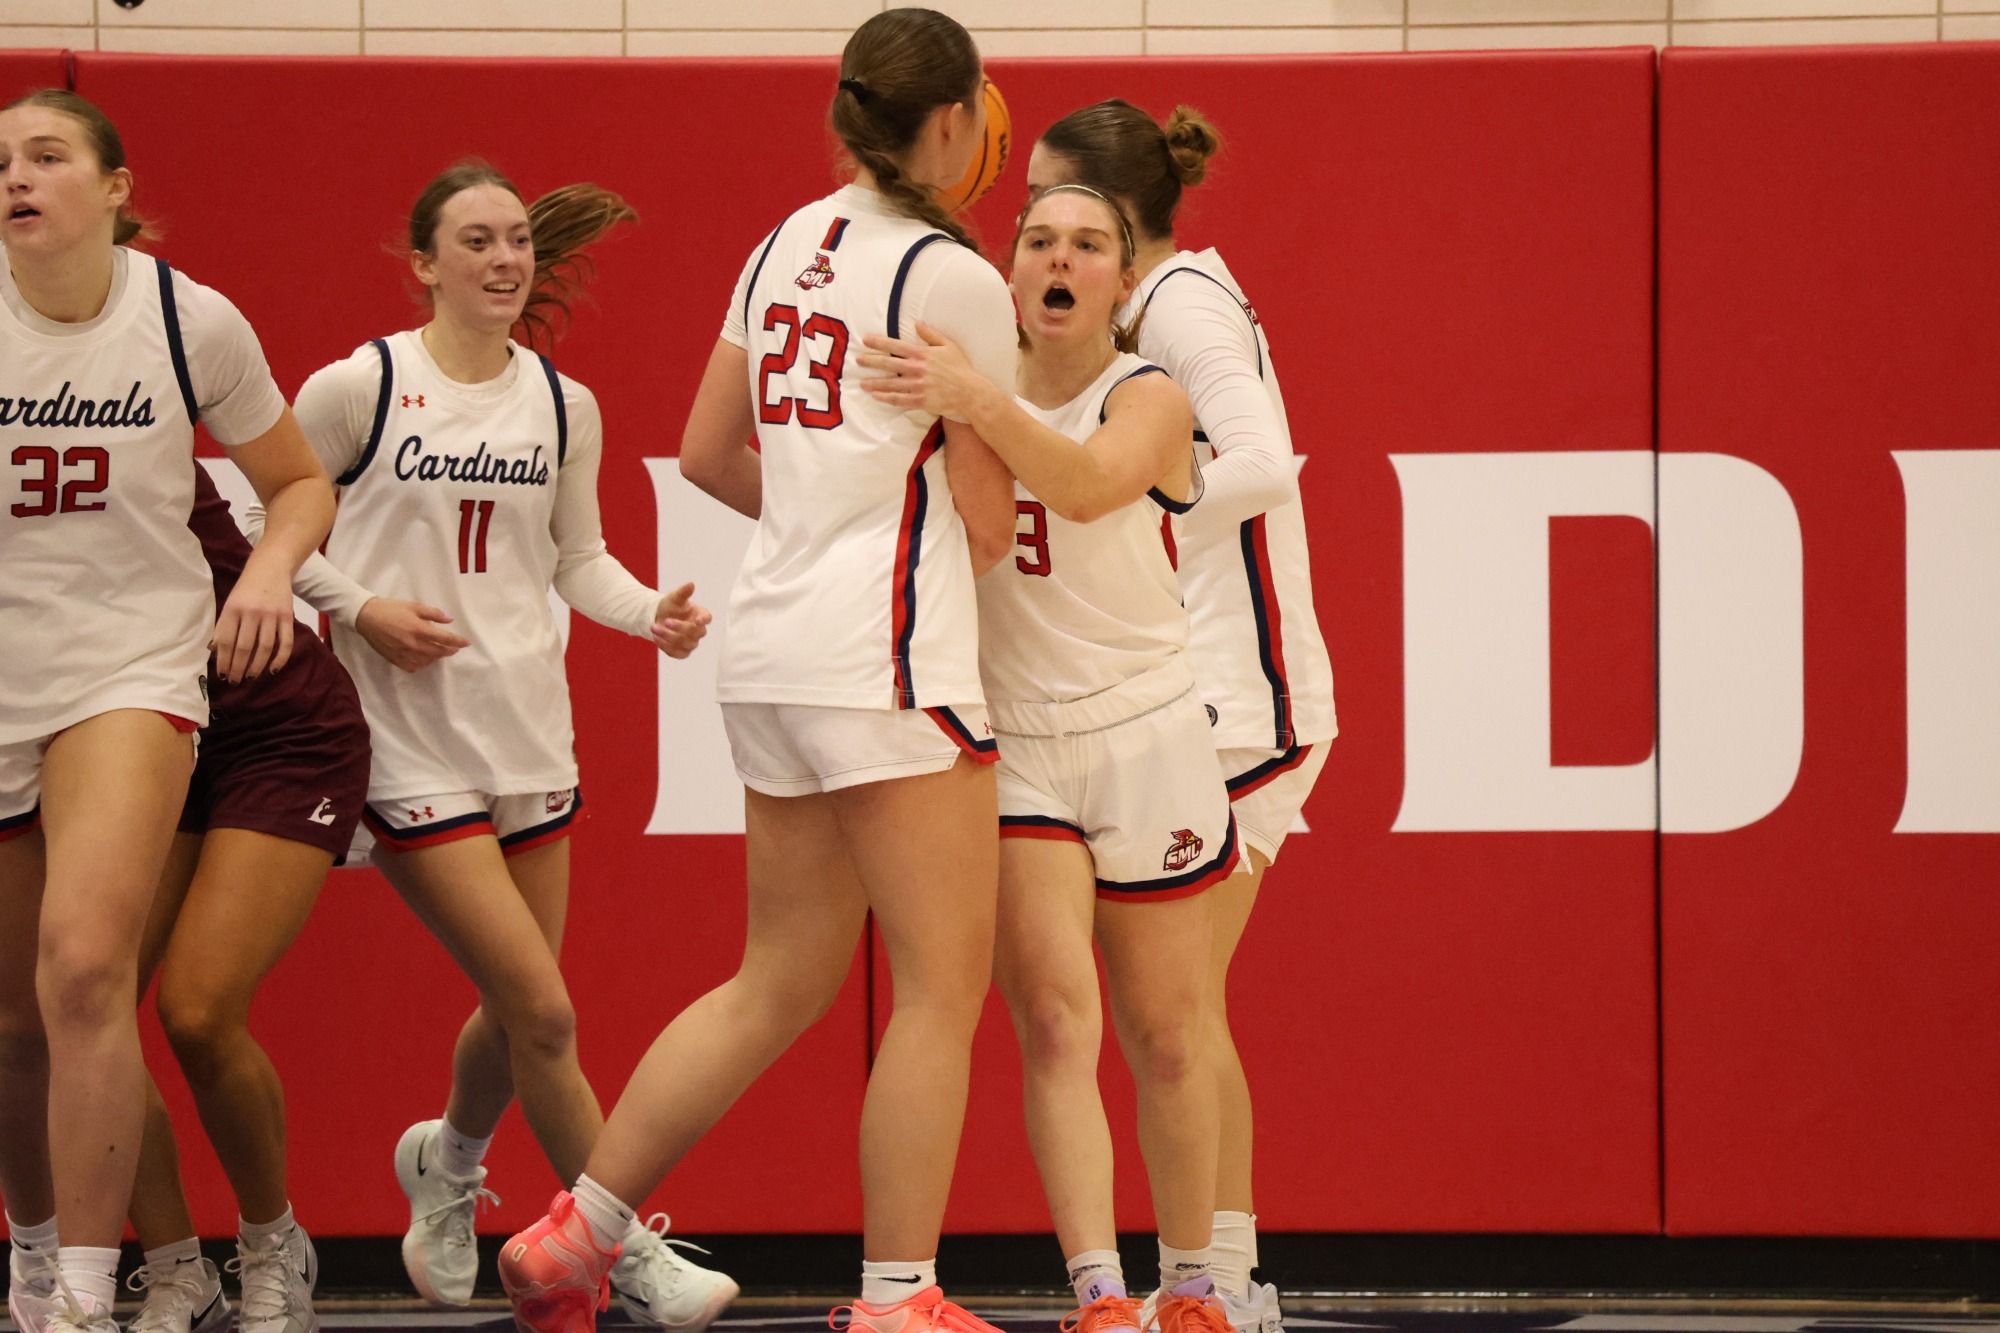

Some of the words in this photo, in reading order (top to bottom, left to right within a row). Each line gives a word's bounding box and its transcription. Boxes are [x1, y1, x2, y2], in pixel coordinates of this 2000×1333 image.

[759, 302, 849, 430] 23
[0, 381, 155, 428] ardinals
[11, 446, 109, 518] 32
[395, 435, 548, 486] Cardinals
[458, 499, 495, 573] 11
[1014, 500, 1051, 577] 3
